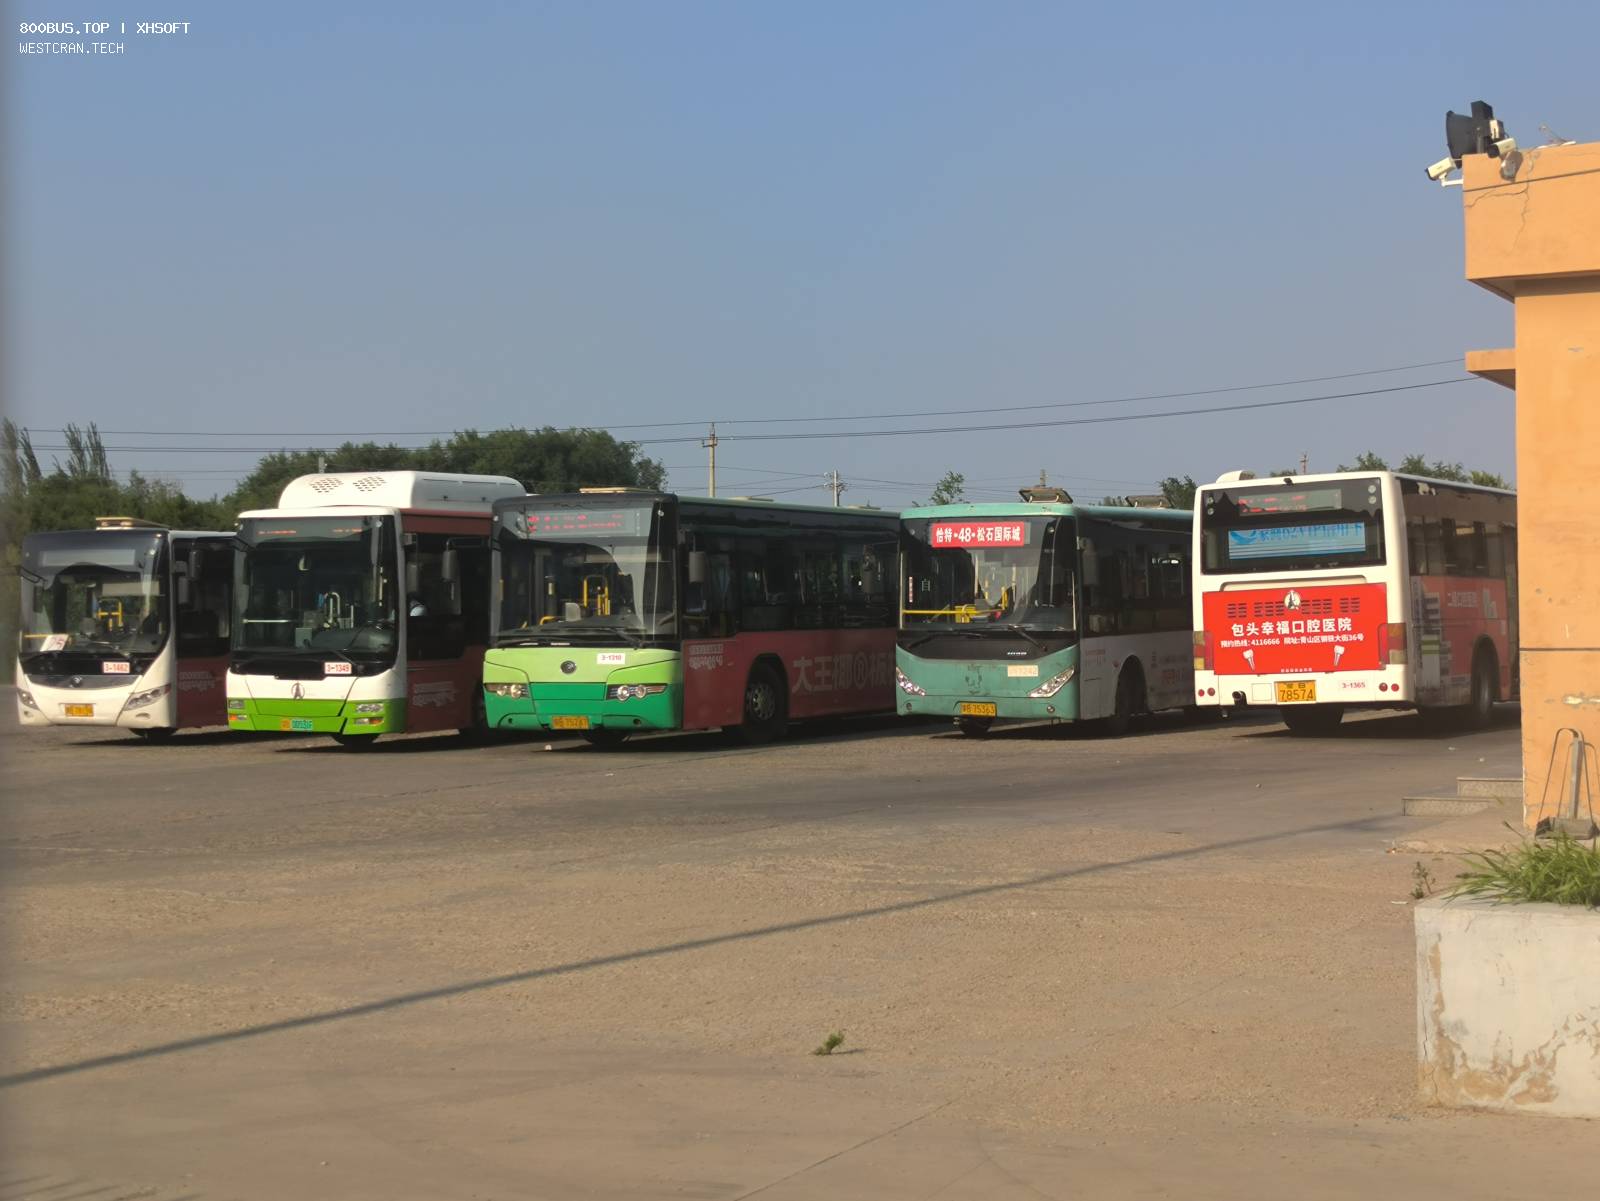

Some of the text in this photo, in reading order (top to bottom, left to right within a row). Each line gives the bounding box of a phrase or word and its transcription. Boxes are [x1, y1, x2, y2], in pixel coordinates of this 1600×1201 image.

[1231, 617, 1352, 637] 包头幸福口腔医院
[1279, 689, 1314, 701] 78574
